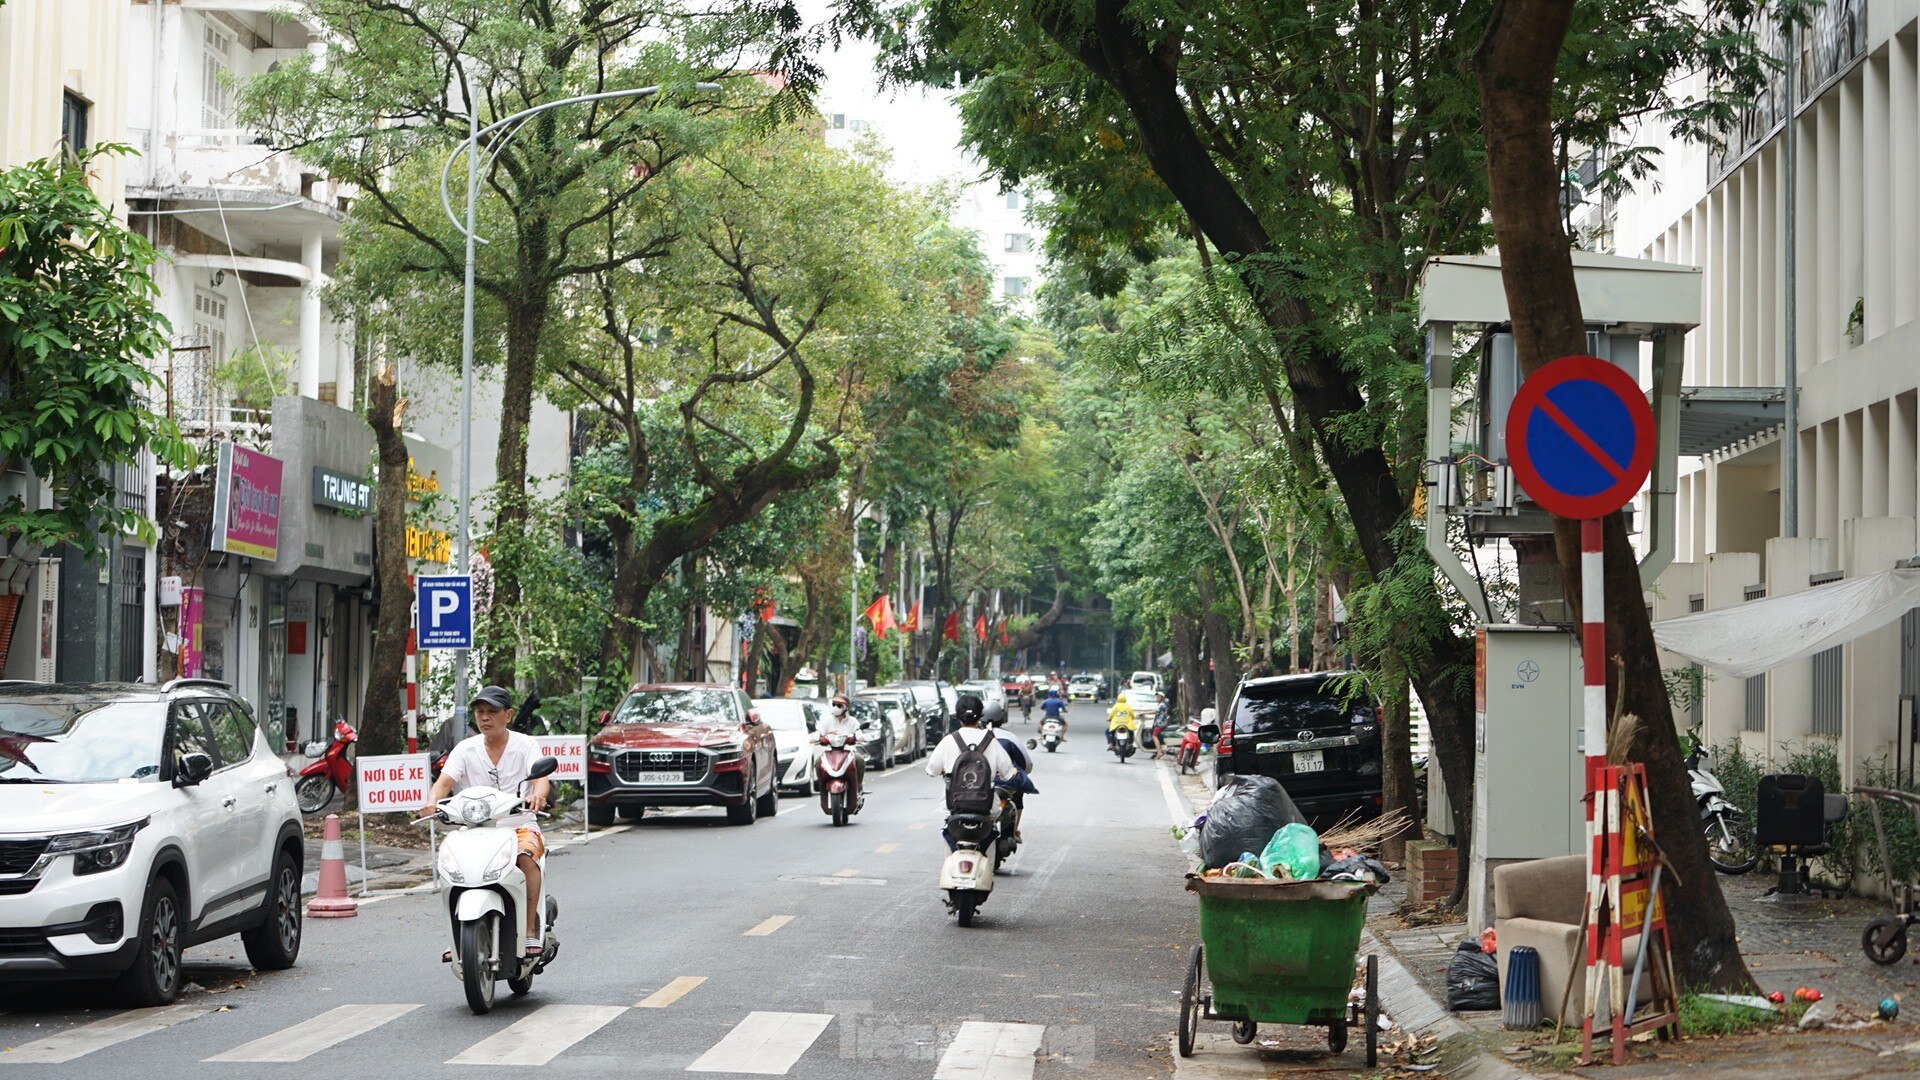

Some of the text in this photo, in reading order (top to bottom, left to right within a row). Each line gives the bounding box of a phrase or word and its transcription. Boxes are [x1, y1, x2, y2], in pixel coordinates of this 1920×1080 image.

[323, 474, 356, 506] TRUNG
[432, 590, 460, 628] P
[570, 746, 582, 756] XE
[364, 763, 424, 782] NƠI ĐỂ XE
[369, 789, 422, 804] CƠ QUAN
